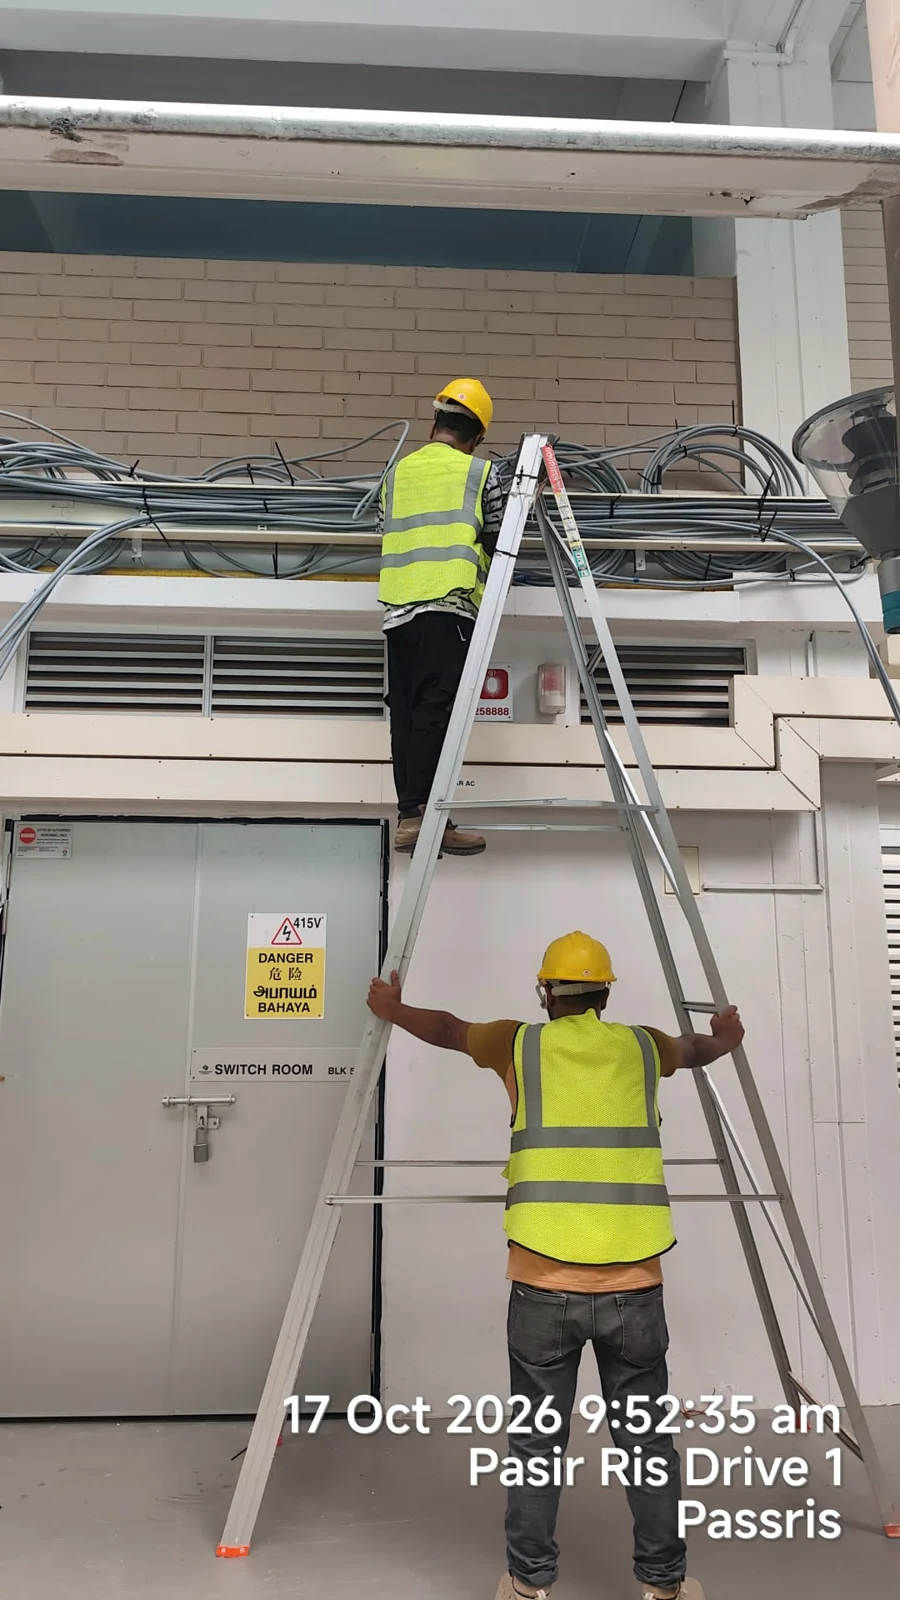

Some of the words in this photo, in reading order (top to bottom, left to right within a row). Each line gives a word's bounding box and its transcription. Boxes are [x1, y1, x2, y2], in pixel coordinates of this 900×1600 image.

[293, 917, 321, 929] 415V
[258, 953, 313, 964] DANGER
[258, 1002, 310, 1013] BAHAYA
[214, 1063, 267, 1076] SWITCH
[271, 1063, 314, 1076] ROOM
[327, 1066, 347, 1076] BLK
